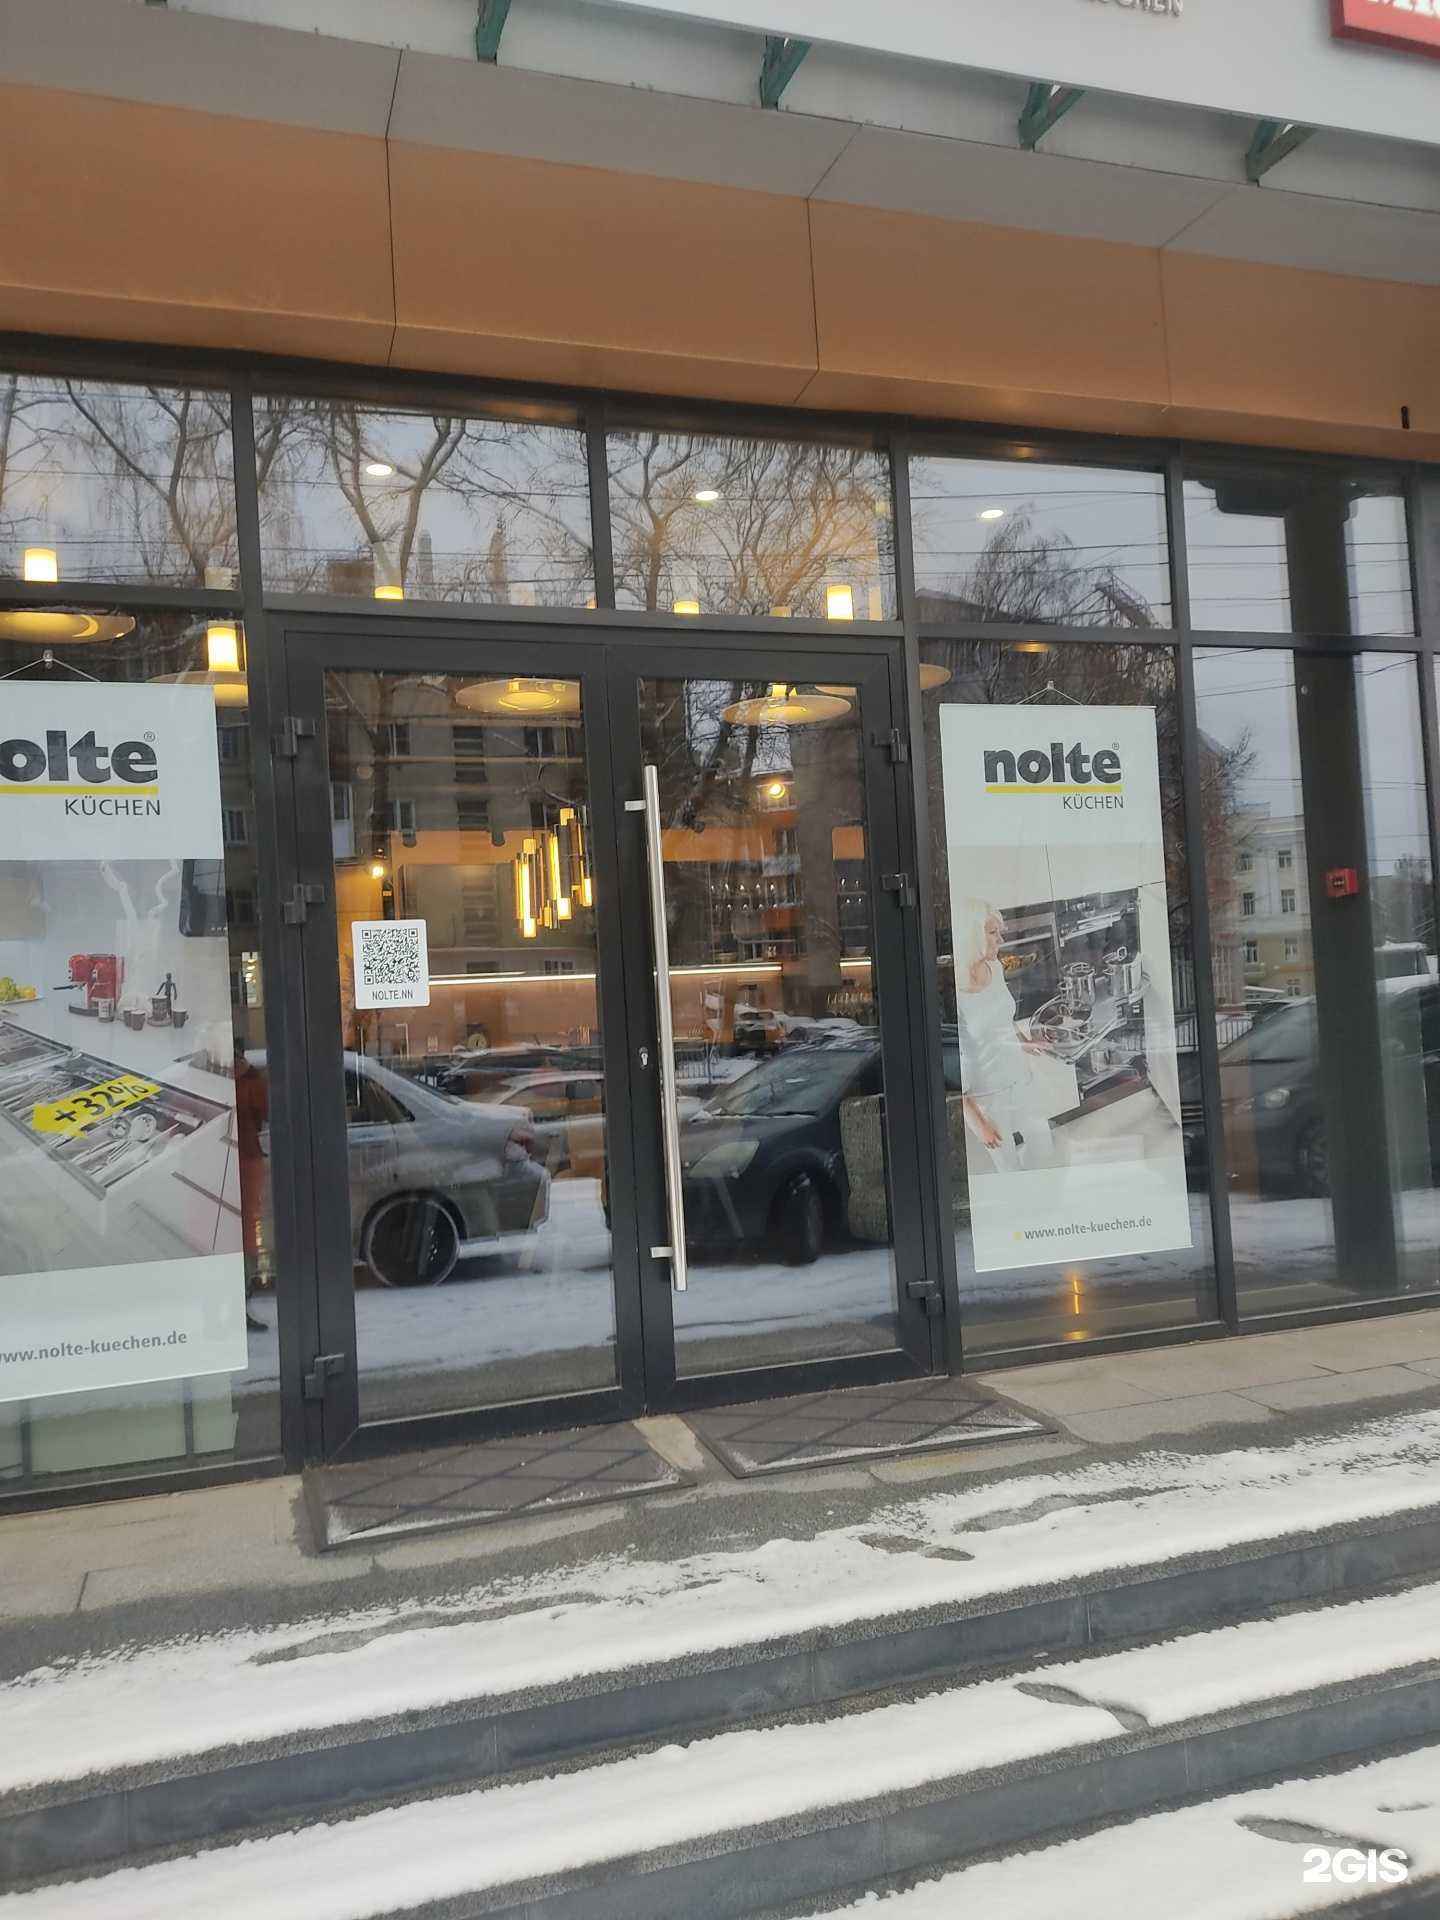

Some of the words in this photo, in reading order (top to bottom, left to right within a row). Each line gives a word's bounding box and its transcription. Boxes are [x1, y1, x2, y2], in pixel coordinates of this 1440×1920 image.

[0, 730, 158, 784] olte
[983, 742, 1122, 784] nolte
[65, 796, 161, 816] KÜCHEN
[1063, 793, 1124, 810] KÜCHEN
[371, 989, 414, 1001] NOLTE.NN
[54, 1081, 149, 1123] +32%
[1024, 1215, 1152, 1240] www.nolte-kuechen.de
[0, 1329, 188, 1364] ww.nolte-kuechen.de
